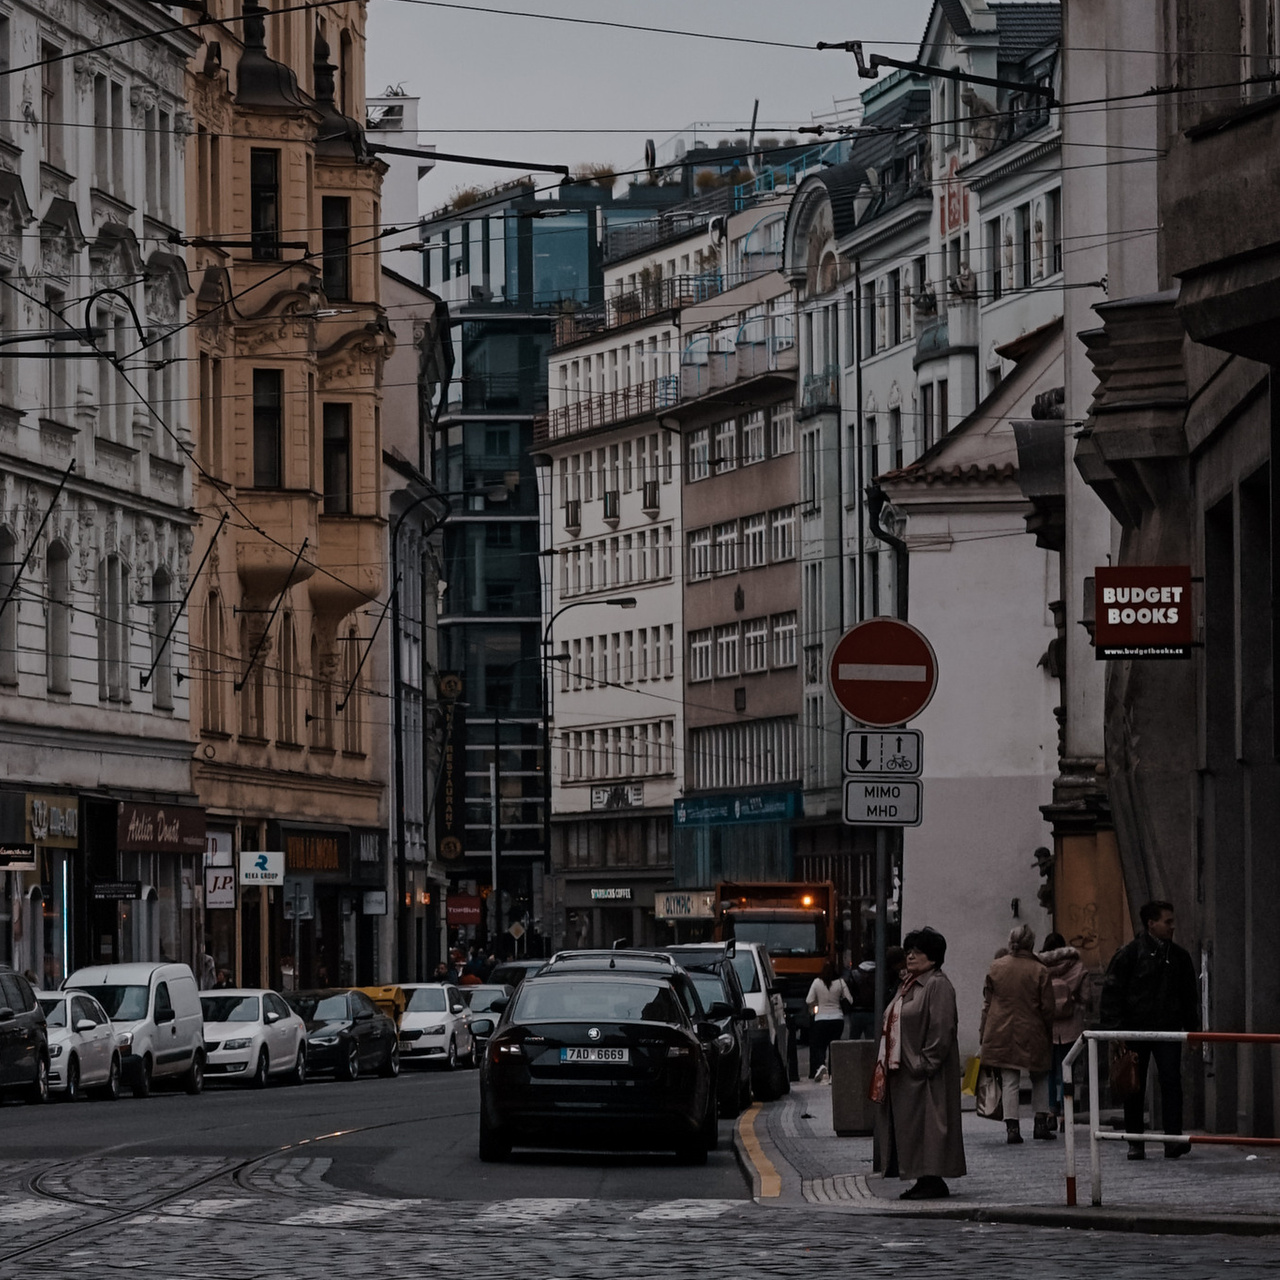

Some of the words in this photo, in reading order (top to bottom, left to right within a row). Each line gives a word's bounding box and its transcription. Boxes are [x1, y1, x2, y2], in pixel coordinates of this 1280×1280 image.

[1103, 586, 1184, 604] BUDGET
[1107, 607, 1179, 625] BOOKS
[445, 745, 454, 830] RESTAURANT
[864, 786, 901, 798] MIMO
[866, 805, 898, 817] MHD
[209, 876, 233, 894] J.P.
[569, 1049, 589, 1060] 7AD
[597, 1049, 624, 1060] 6669
